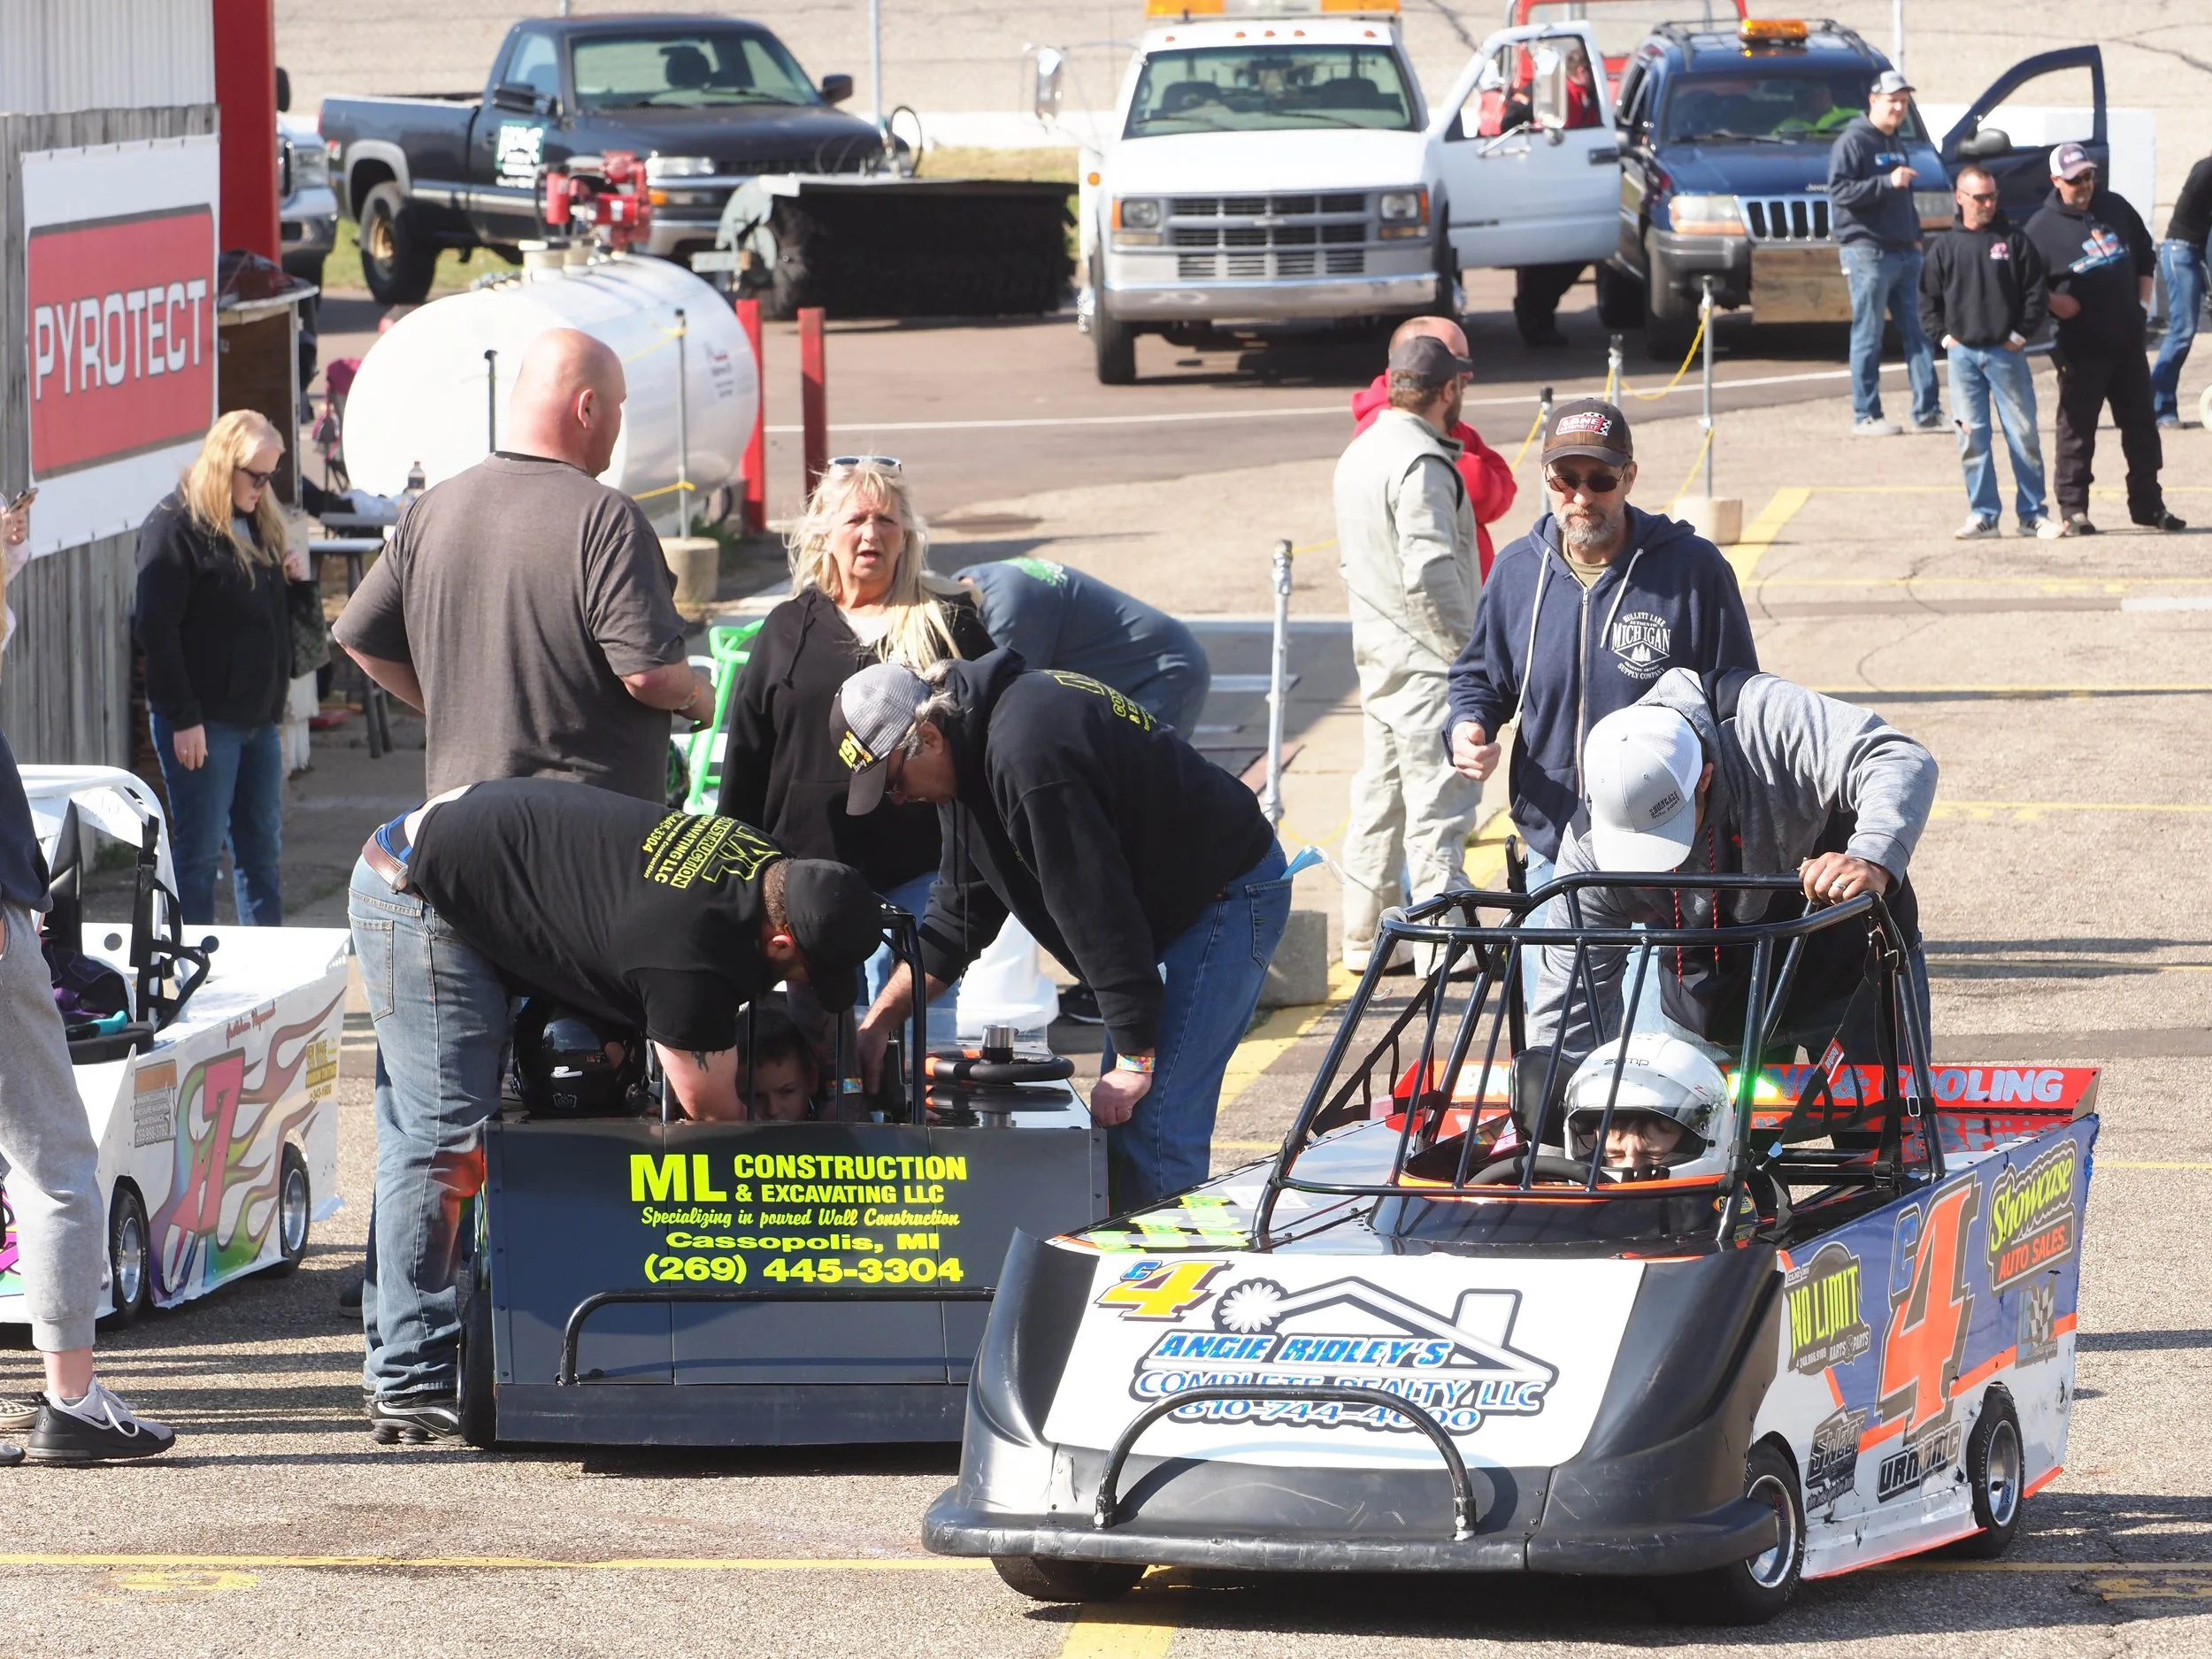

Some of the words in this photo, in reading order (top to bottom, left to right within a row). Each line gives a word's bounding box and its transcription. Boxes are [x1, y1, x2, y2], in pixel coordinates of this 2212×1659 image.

[34, 277, 206, 401] PYROTECT
[1623, 611, 1648, 624] MULLETT
[1650, 614, 1666, 627] LAKE
[1611, 622, 1671, 653] MICHIGAN
[1617, 662, 1639, 680] SUPPLY
[1640, 666, 1665, 680] COMPANY
[670, 816, 737, 889] ONSTRUCTION
[654, 858, 679, 884] LLC
[630, 1154, 727, 1202] ML
[733, 1154, 967, 1180] CONSTRUCTION
[735, 1184, 753, 1202] &
[761, 1184, 896, 1203] EXCAVATING
[903, 1185, 945, 1203] LLC
[1991, 1157, 2072, 1252] Showcase
[641, 1207, 733, 1228] Specializing
[737, 1209, 754, 1225] in
[759, 1209, 812, 1228] poured
[818, 1208, 858, 1226] Wall
[864, 1208, 961, 1226] Construction
[665, 1232, 884, 1254] Cassopolis,
[896, 1233, 941, 1249] MI
[1997, 1243, 2030, 1282] AUTO
[2032, 1225, 2066, 1264] SALES
[644, 1253, 748, 1284] (269)
[763, 1257, 964, 1283] 445-3304
[1789, 1286, 1812, 1359] NO
[1813, 1265, 1859, 1342] LIMIT
[1154, 1334, 1273, 1360] ANGIE
[1279, 1337, 1450, 1365] RIDLEY'S
[1828, 1340, 1847, 1362] KARTS
[1853, 1330, 1869, 1351] PARTS
[1480, 1384, 1543, 1407] LLC
[1807, 1415, 1865, 1482] SWEET
